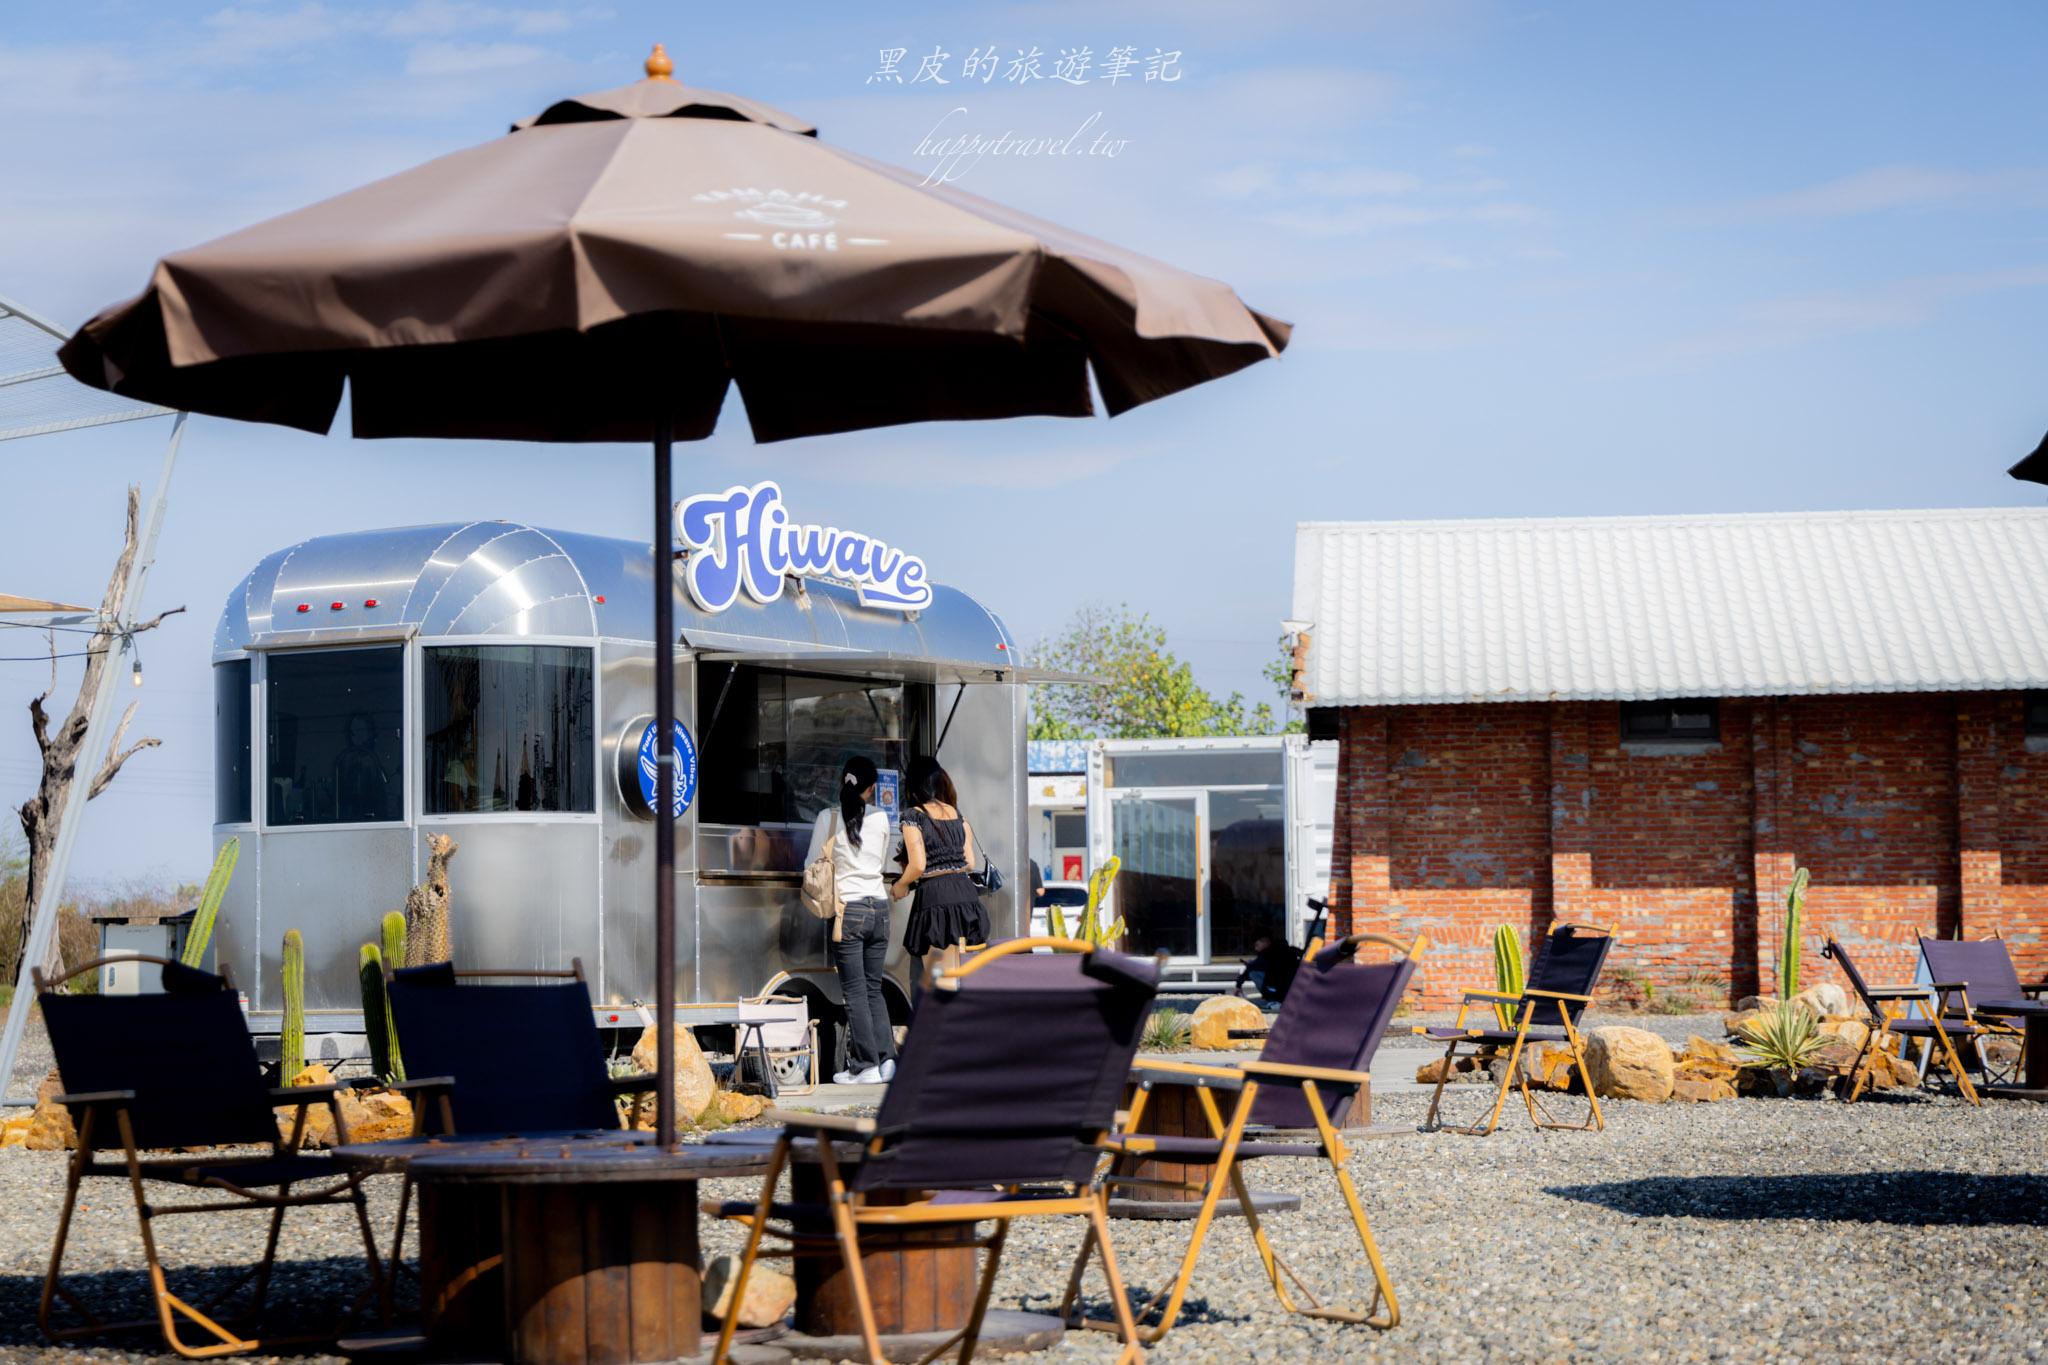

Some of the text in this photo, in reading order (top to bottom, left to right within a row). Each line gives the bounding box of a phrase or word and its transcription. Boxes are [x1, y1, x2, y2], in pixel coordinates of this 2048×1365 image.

[771, 231, 838, 251] CAFÉ
[677, 481, 931, 612] Hiwave
[642, 731, 653, 753] Fuel
[675, 724, 693, 754] Hiwave
